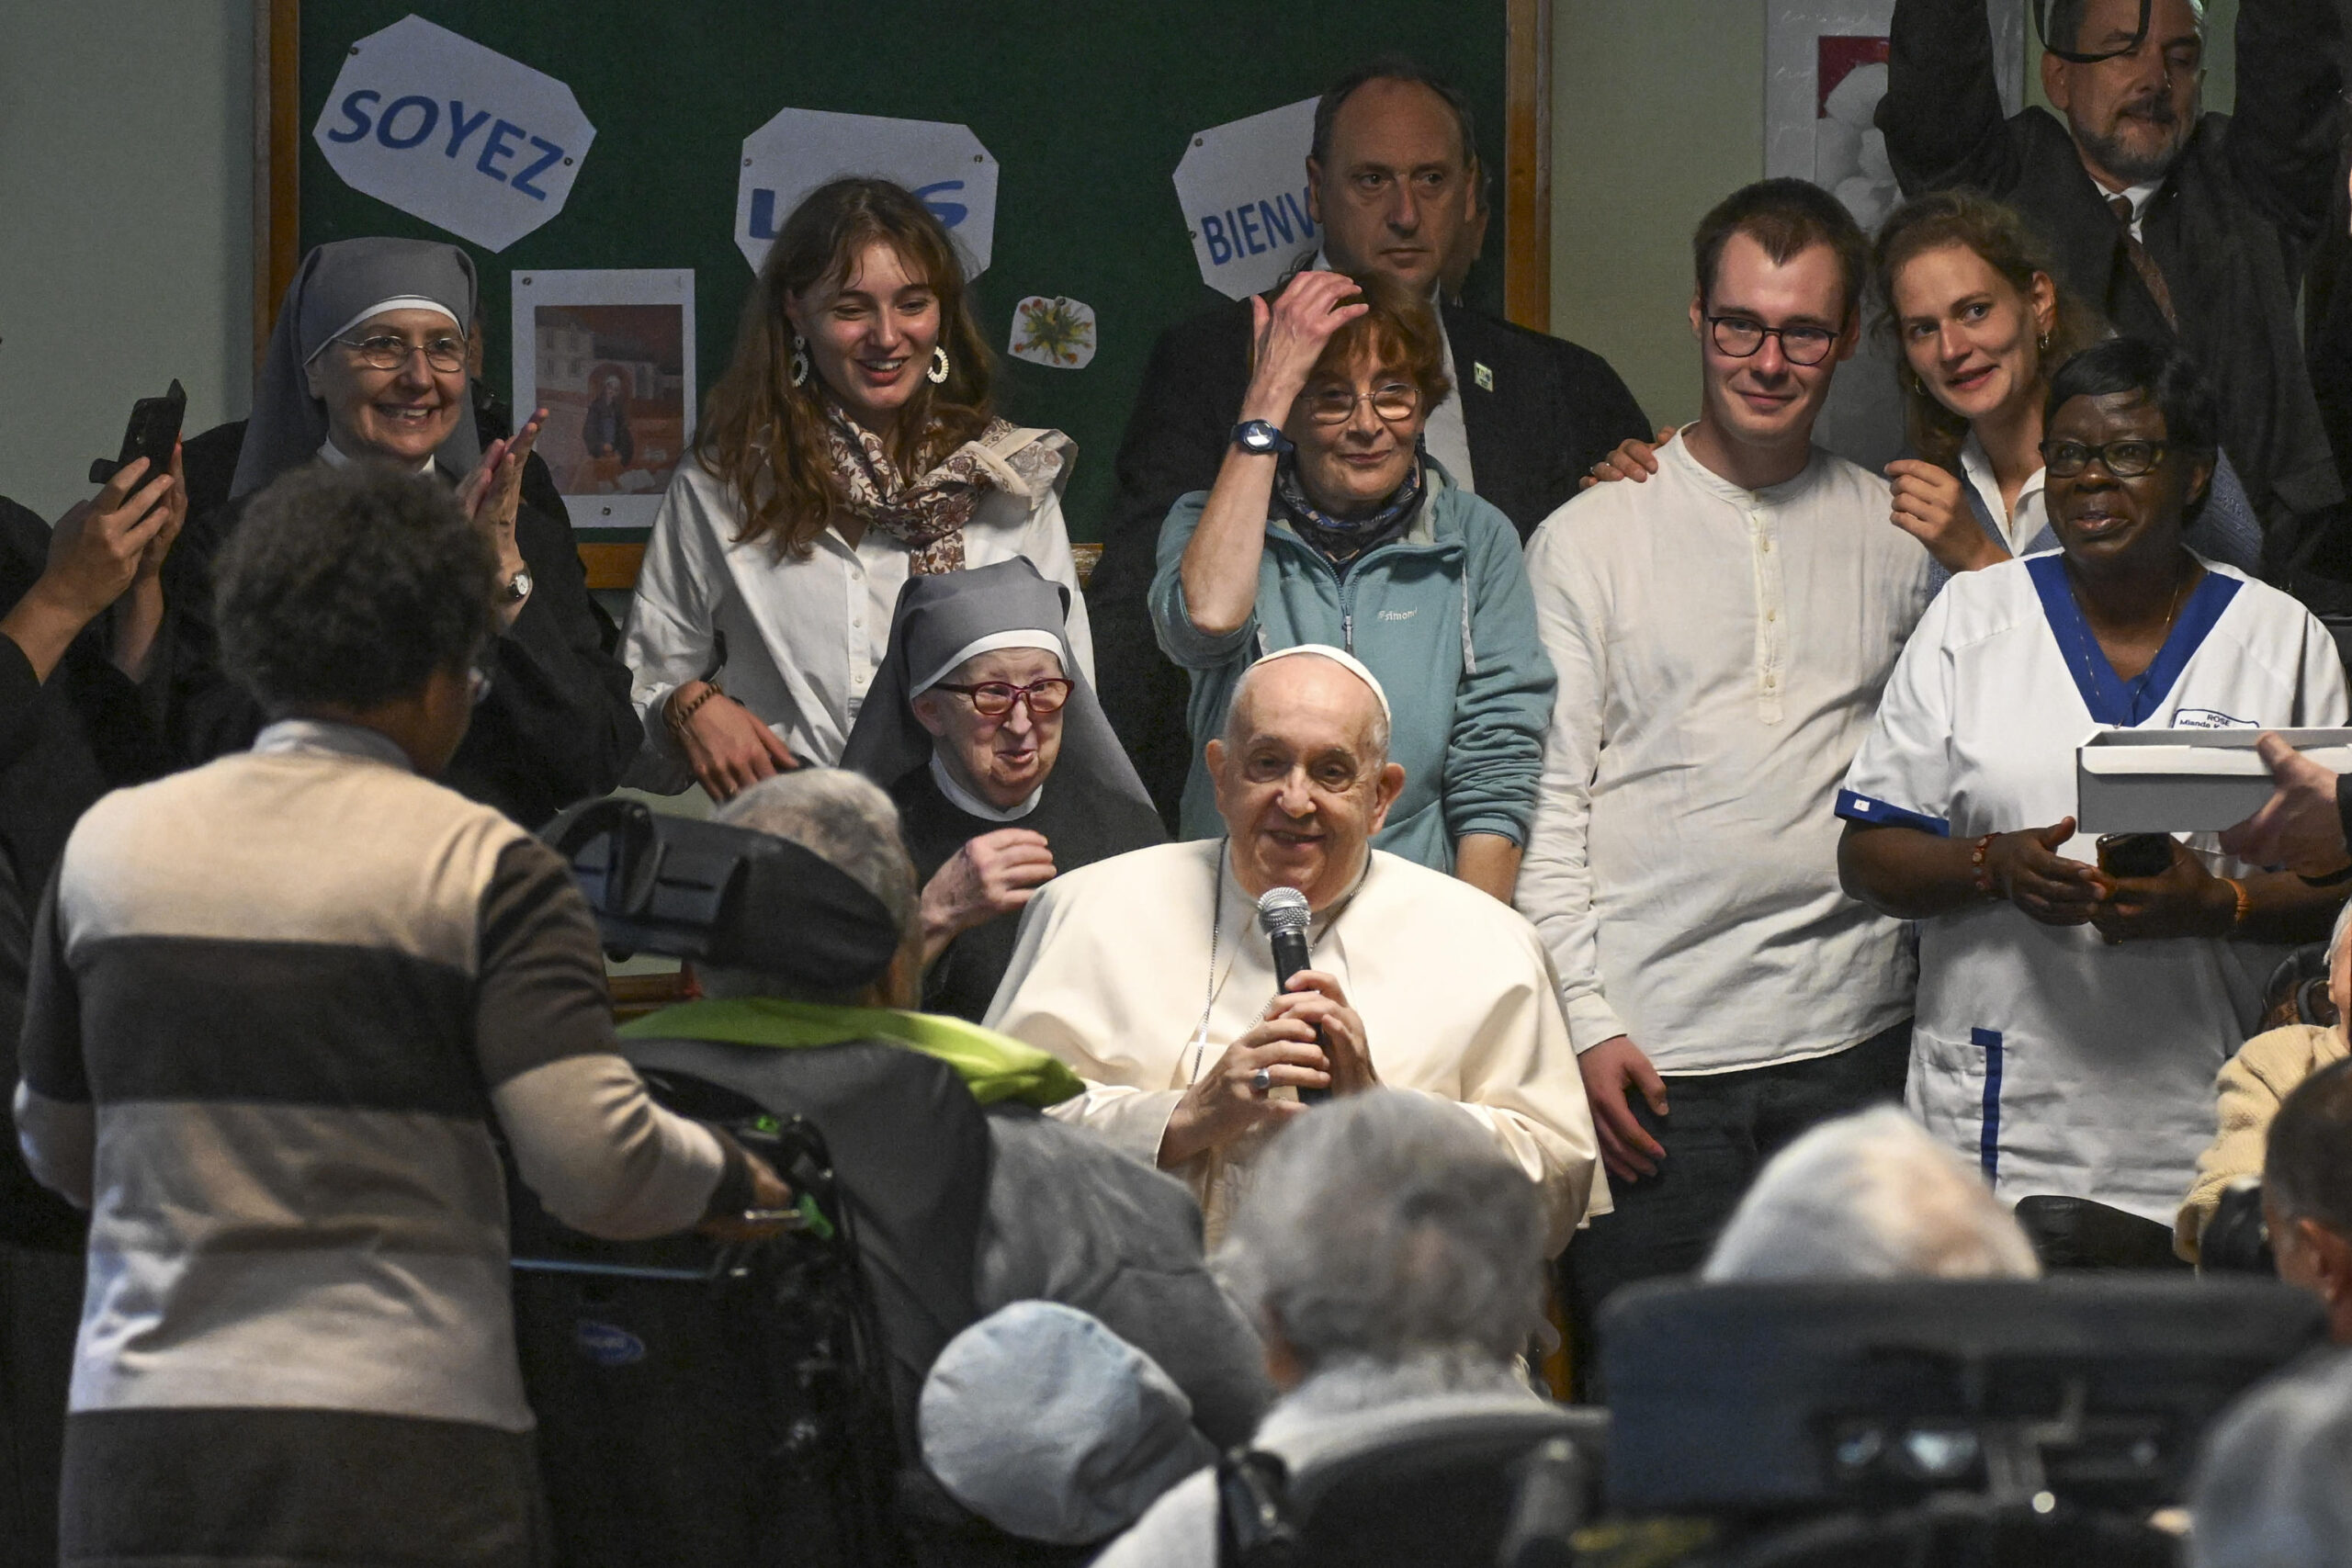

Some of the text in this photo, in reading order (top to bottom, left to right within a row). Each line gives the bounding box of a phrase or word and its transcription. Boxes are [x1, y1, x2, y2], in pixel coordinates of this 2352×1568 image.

[328, 89, 564, 201] SOYEZ
[749, 180, 968, 240] LS
[1201, 186, 1315, 265] BIENV
[2207, 714, 2231, 727] ROSE
